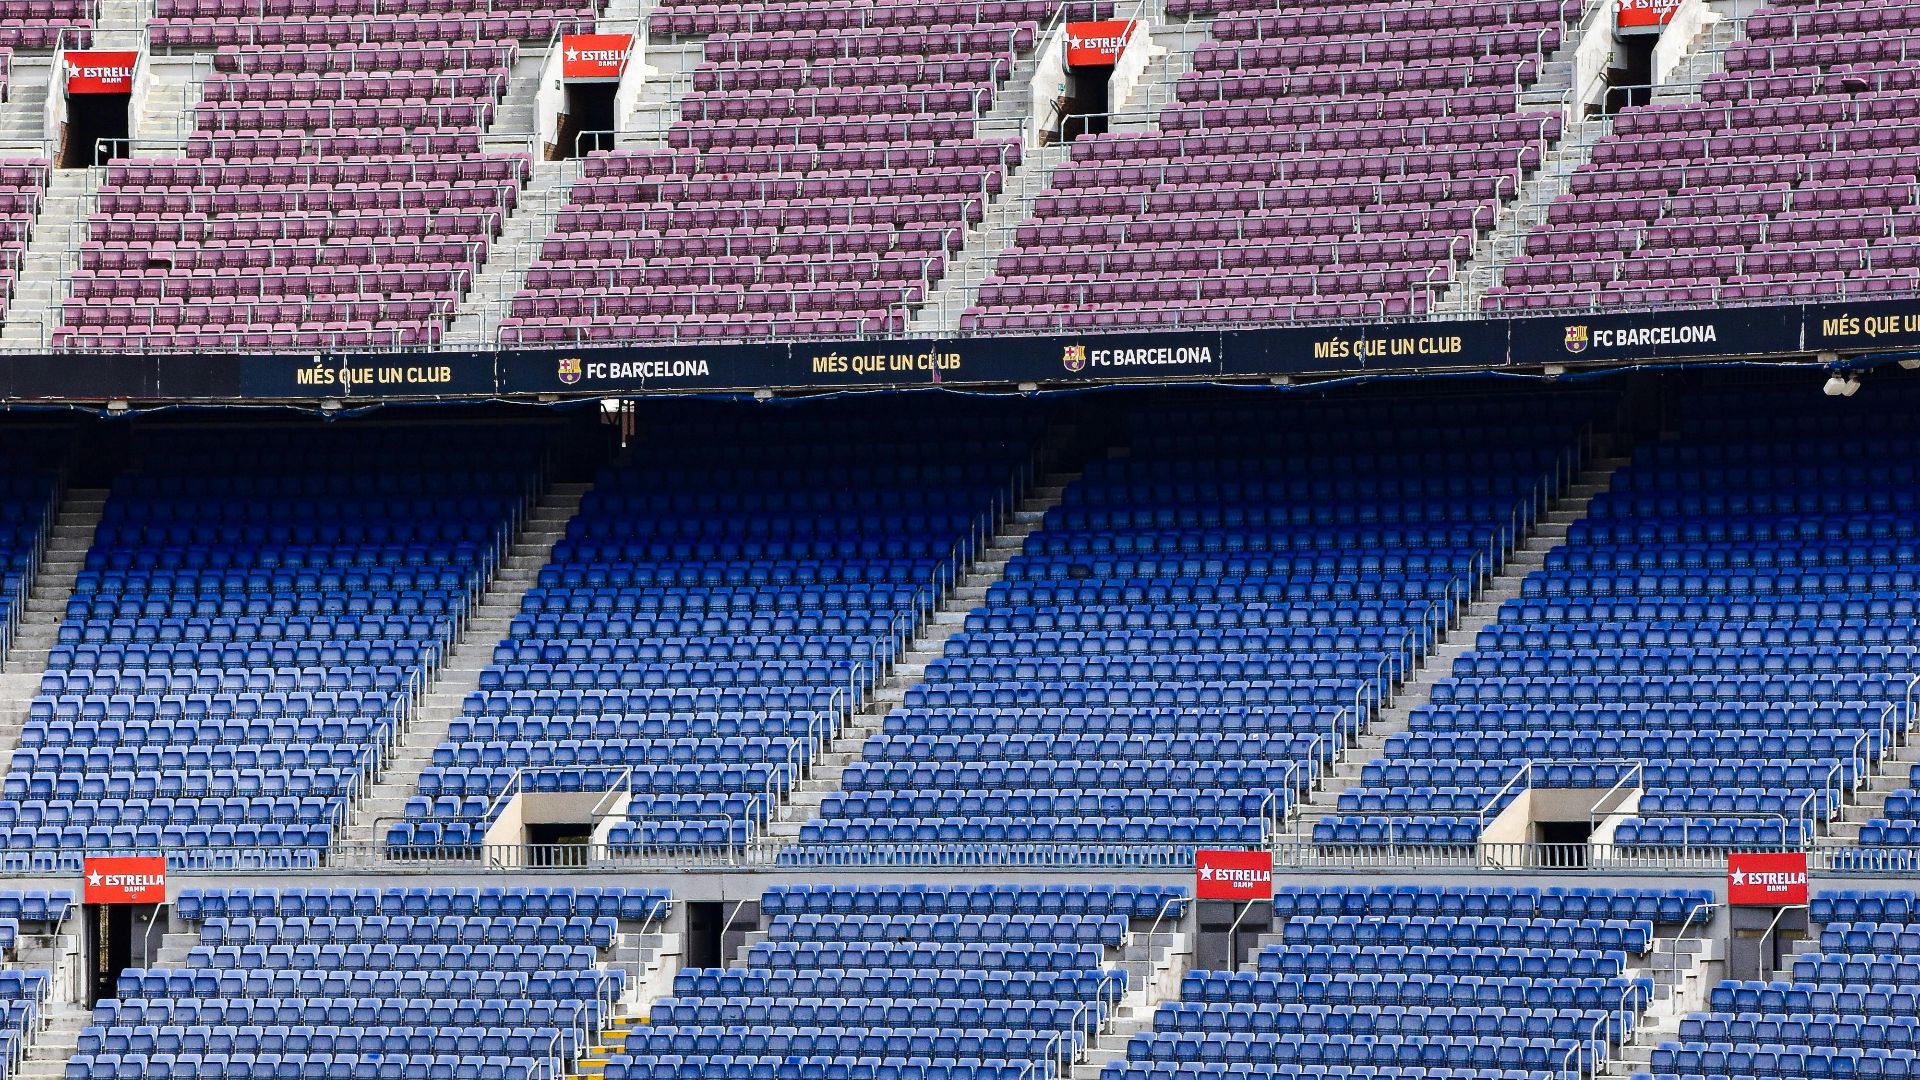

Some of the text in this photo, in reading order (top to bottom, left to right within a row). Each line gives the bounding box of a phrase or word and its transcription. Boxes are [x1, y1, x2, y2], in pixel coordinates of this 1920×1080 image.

[1084, 37, 1131, 48] ESTRELL
[581, 50, 630, 61] ESTRELL
[83, 67, 134, 78] ESTRELL
[1823, 313, 1920, 338] MÉS QUE U
[1593, 325, 1717, 347] FC BARCELONA
[1091, 346, 1212, 366] FC BARCELONA
[1314, 336, 1350, 358] MÉS
[1390, 338, 1415, 356] UN
[1418, 336, 1462, 354] CLUB
[587, 359, 710, 379] FC BARCELONA
[812, 351, 961, 375] MÉS QUE UN CLUB
[297, 363, 451, 386] MÉS QUE UN CLUB
[105, 874, 165, 886] ESTRELLA
[1215, 868, 1271, 882] ESTRELLA
[1748, 872, 1807, 885] ESTRELLA
